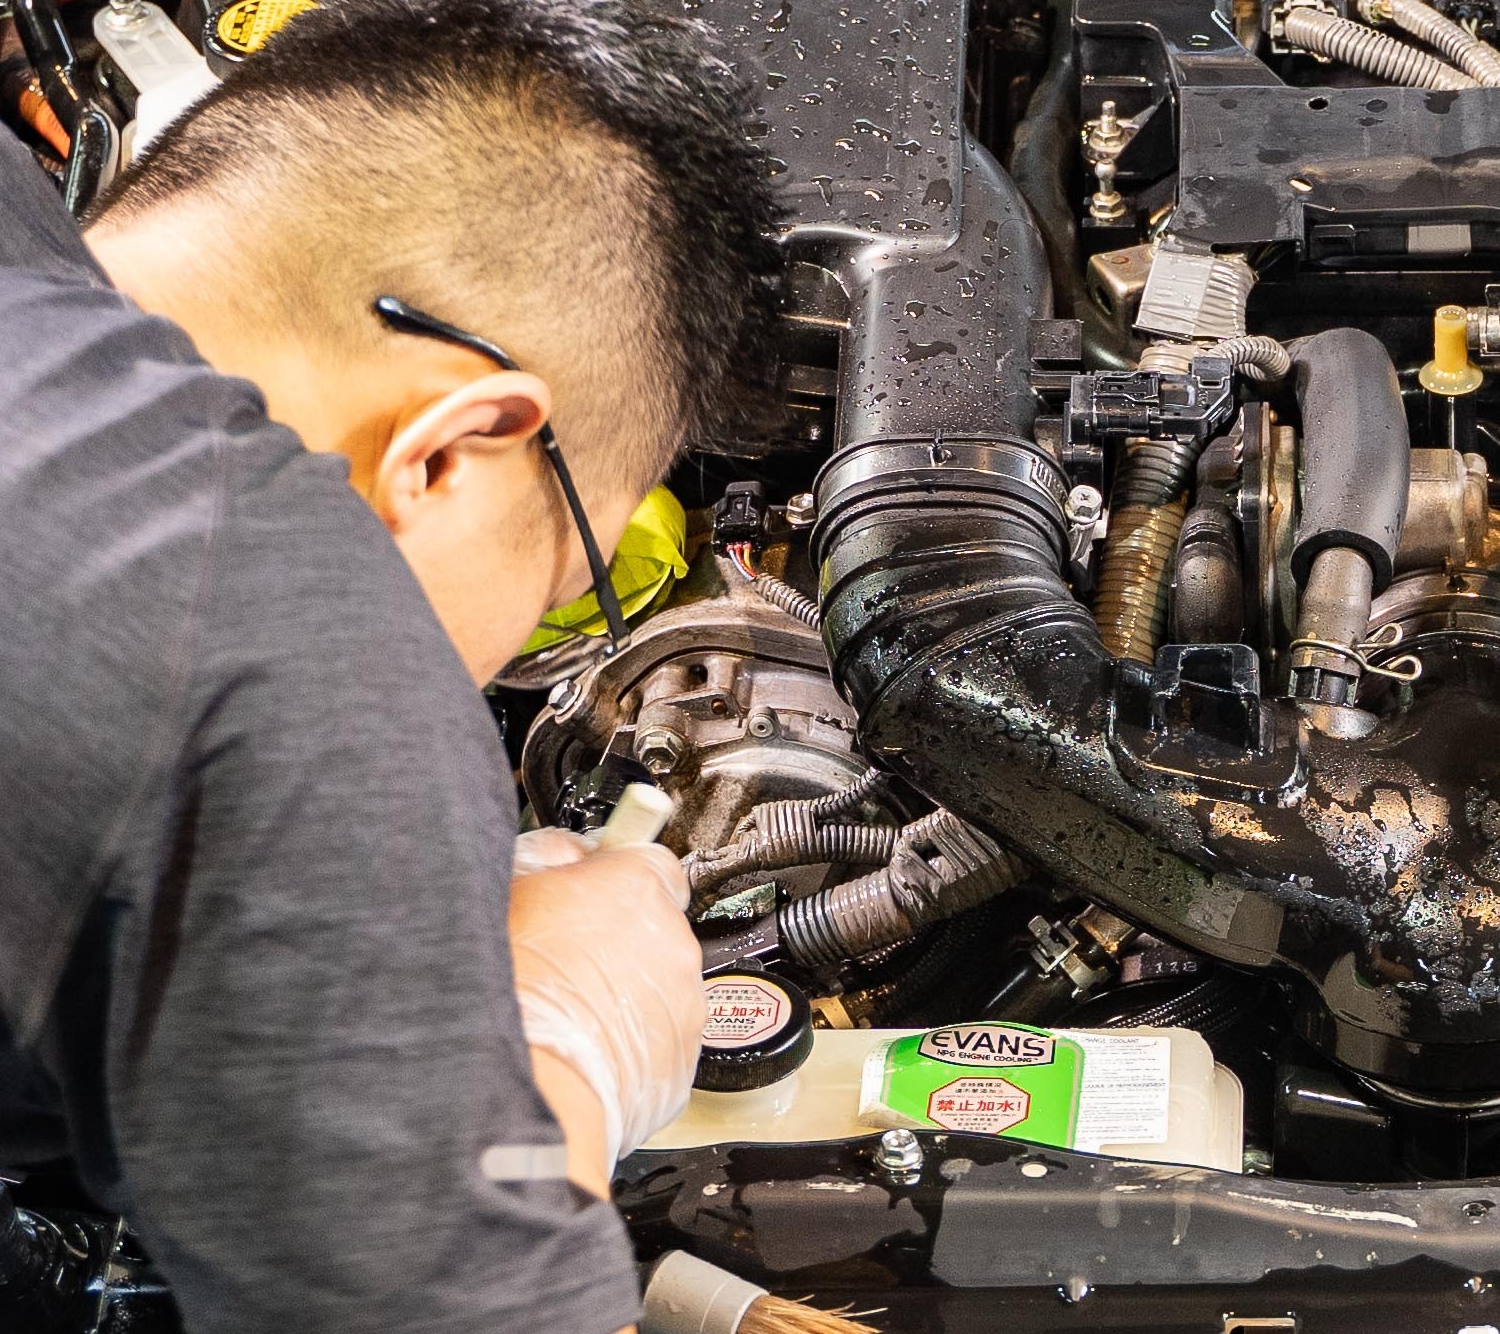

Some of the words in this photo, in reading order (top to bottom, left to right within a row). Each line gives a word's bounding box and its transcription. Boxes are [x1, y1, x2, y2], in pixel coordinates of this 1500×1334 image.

[707, 1005, 772, 1018] 止加水!
[930, 1030, 1045, 1057] EVANS
[958, 1051, 991, 1061] ENGINE
[993, 1055, 1033, 1063] COOLING
[936, 1099, 1021, 1113] 禁止加水!
